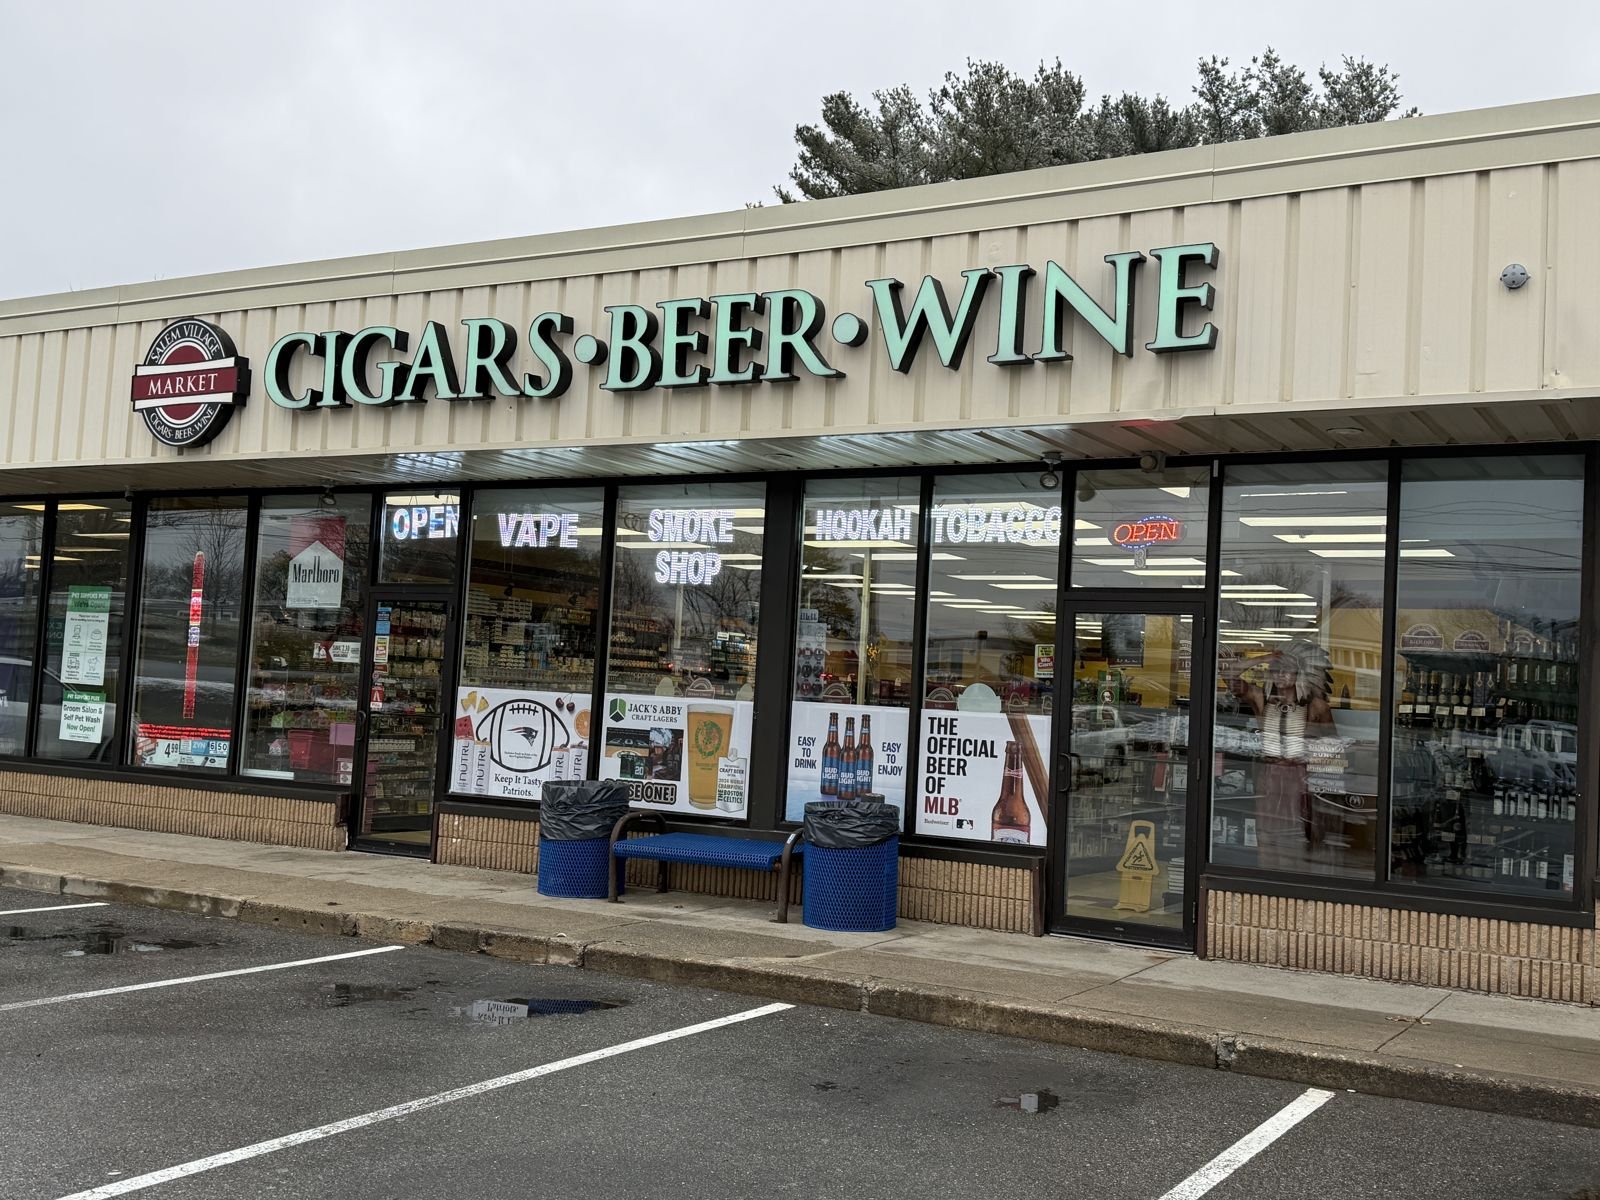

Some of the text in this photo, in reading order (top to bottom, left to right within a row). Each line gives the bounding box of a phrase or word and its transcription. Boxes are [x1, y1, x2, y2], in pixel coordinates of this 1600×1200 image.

[264, 243, 1217, 410] CIGARS BEER WINE
[151, 324, 220, 363] SALEM VILLAGE
[147, 373, 218, 396] MARKET
[195, 406, 215, 431] WINE
[393, 505, 460, 540] OPEN
[498, 513, 579, 548] VAPE
[648, 508, 736, 543] SMOKE
[816, 509, 911, 541] HOOKAH
[1113, 521, 1178, 543] OPEN
[292, 555, 340, 583] Marlboro
[655, 550, 721, 585] SHOP
[63, 704, 80, 713] Groom
[82, 706, 97, 714] Salon
[63, 713, 74, 721] Self
[628, 703, 683, 716] JACK'S ABBY
[631, 714, 653, 722] CRAFT
[66, 723, 96, 733] Now Open!
[928, 717, 959, 736] THE
[192, 742, 206, 750] ZYN
[797, 736, 816, 747] EASY
[882, 742, 901, 753] EASY
[927, 736, 998, 758] OFFICIAL
[802, 748, 811, 758] TO
[886, 754, 896, 764] TO
[634, 766, 644, 775] 20
[794, 758, 817, 769] DRINK
[878, 765, 903, 776] ENJOY
[926, 756, 968, 776] BEER
[494, 773, 543, 787] Keep It Tasty
[925, 776, 946, 795] OF
[502, 786, 534, 797] Patriots.
[644, 784, 675, 802] ONE!
[723, 796, 743, 804] CELTICS
[924, 796, 959, 816] MLB
[923, 818, 950, 826] Budweiser
